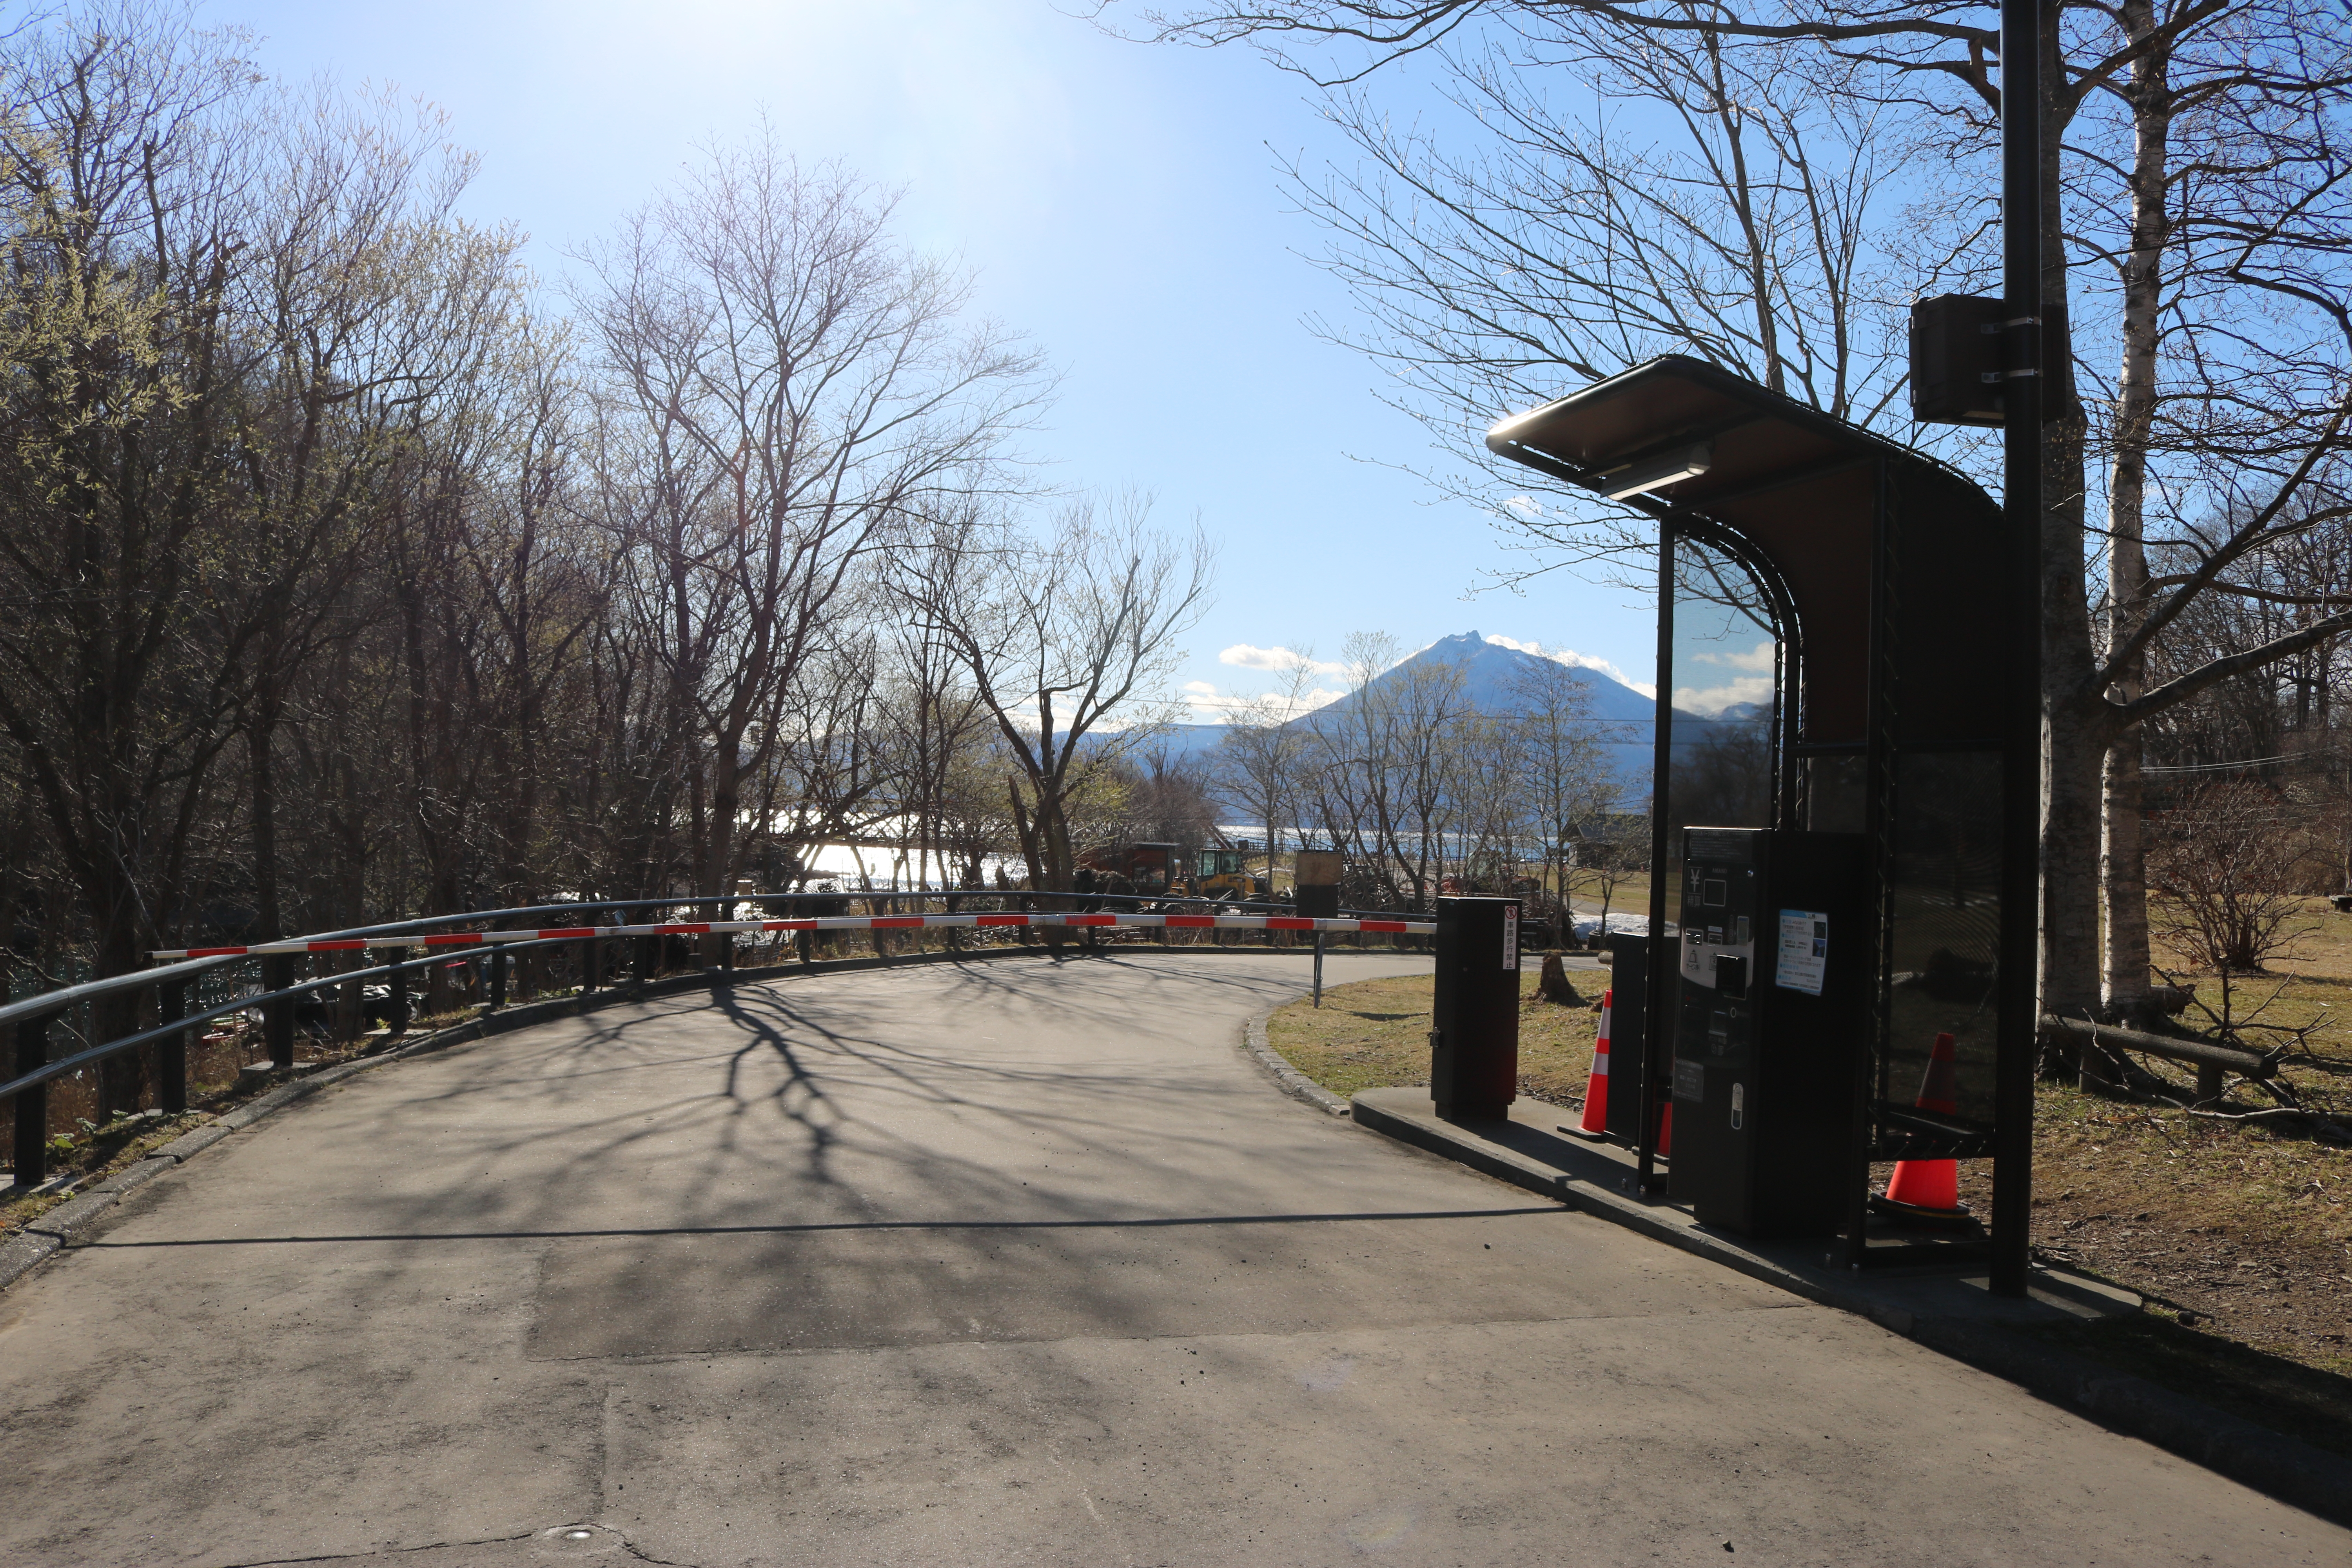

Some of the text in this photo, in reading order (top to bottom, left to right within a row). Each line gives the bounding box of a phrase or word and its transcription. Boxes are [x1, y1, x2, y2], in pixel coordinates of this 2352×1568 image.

[1506, 921, 1514, 969] 車路歩行禁止
